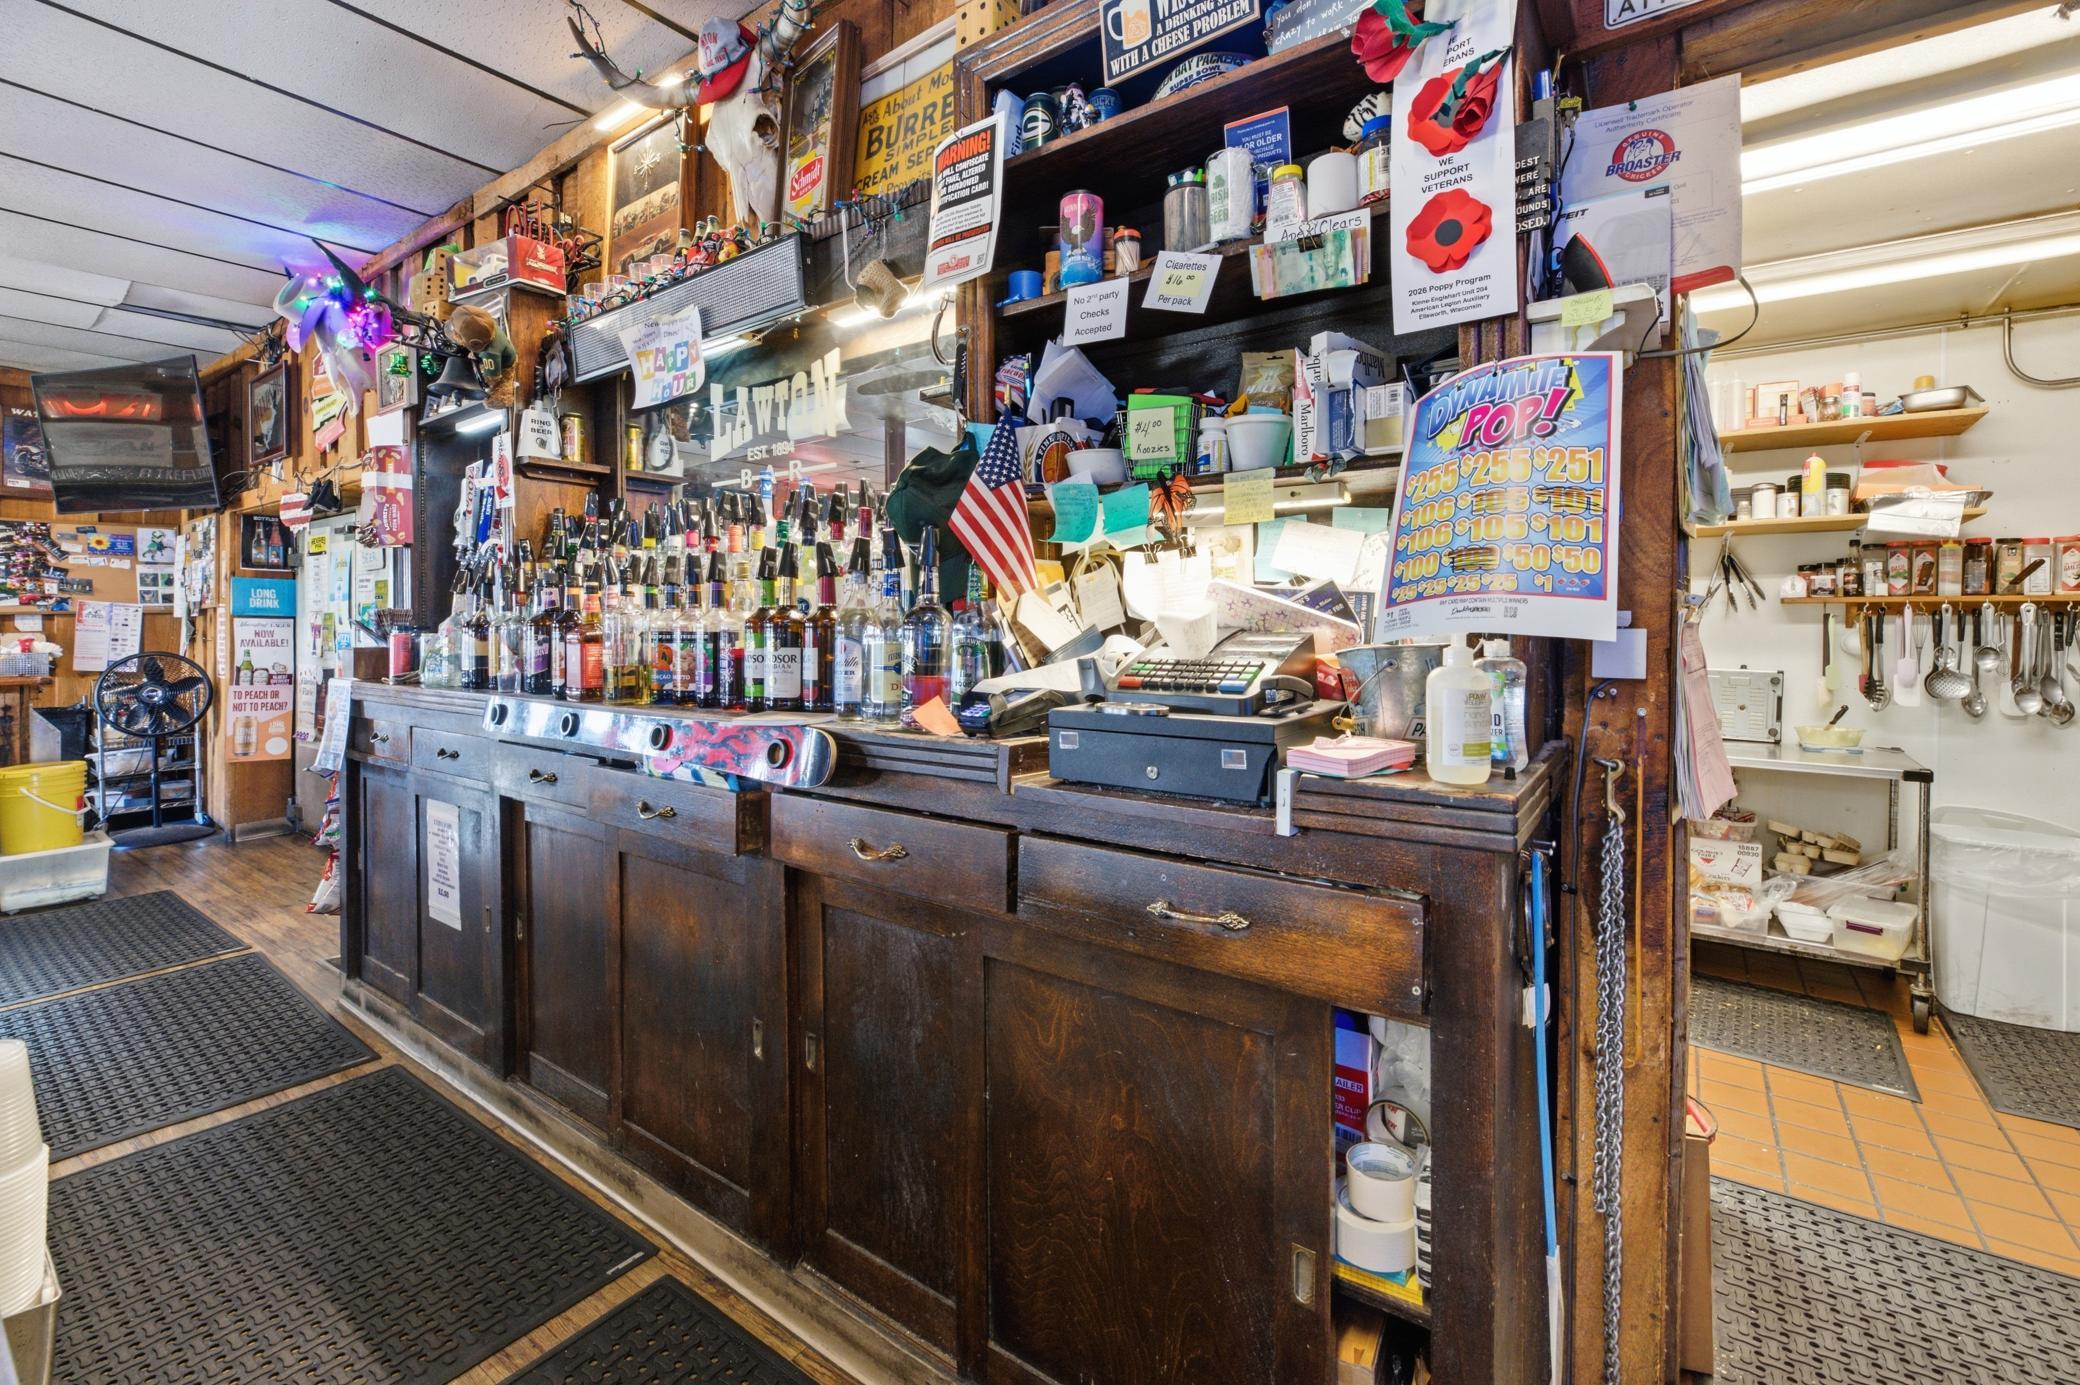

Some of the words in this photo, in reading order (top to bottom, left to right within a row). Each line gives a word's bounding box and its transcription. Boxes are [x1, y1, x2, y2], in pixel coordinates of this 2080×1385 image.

[1156, 23, 1162, 36] A
[1164, 1, 1215, 33] DRINKING
[1110, 51, 1140, 76] WITH
[1141, 45, 1150, 62] A
[1151, 26, 1191, 57] CHEESE
[1193, 1, 1252, 38] PROBLEM
[1174, 58, 1194, 80] BAY
[1195, 53, 1245, 67] PACKERS
[1169, 73, 1196, 92] SUPER
[1195, 63, 1223, 77] BOWL
[883, 86, 922, 120] About
[1626, 109, 1661, 122] Trademark
[1662, 100, 1695, 114] Operator
[1605, 120, 1646, 134] Authenticity
[1646, 110, 1682, 124] Certificate
[884, 120, 954, 162] SIMPLE
[1010, 125, 1023, 156] Find
[1246, 140, 1256, 150] OR
[1257, 133, 1283, 148] OLDER
[1252, 131, 1265, 140] MUST
[1622, 130, 1665, 148] GENUINE
[937, 130, 991, 174] WARNING!
[1438, 156, 1454, 168] WE
[857, 161, 900, 192] CREAM
[906, 141, 942, 170] SEP
[955, 152, 990, 174] CONFISCATE
[961, 163, 986, 179] ALTERED
[1424, 163, 1471, 183] SUPPORT
[1605, 150, 1682, 178] BROASTER
[1624, 165, 1664, 180] CHICKEN
[792, 160, 821, 196] Schmidt
[947, 175, 980, 194] BORROWED
[1421, 173, 1474, 194] VETERANS
[1528, 184, 1548, 198] ARE
[1165, 259, 1208, 272] Cigarettes
[1408, 287, 1428, 298] 2026
[1428, 282, 1454, 294] Poppy
[1455, 274, 1492, 287] Program
[1073, 296, 1086, 306] No
[1086, 293, 1099, 304] 2nd
[1099, 289, 1120, 302] party
[1157, 294, 1172, 305] Per
[1171, 295, 1193, 308] pack
[1410, 303, 1440, 314] American
[1440, 298, 1462, 308] Legion
[1462, 293, 1491, 304] Auxiliary
[1080, 307, 1110, 320] Checks
[1449, 303, 1482, 314] Wisconsin
[1074, 322, 1113, 337] Accepted
[710, 347, 842, 462] LAWTON
[530, 418, 552, 428] RING
[1458, 386, 1572, 450] POP!
[530, 427, 552, 436] BEER
[1300, 403, 1315, 456] Marlboro
[747, 444, 770, 462] EST.
[1038, 431, 1056, 458] FINE
[1136, 443, 1170, 454] Koozies
[1406, 458, 1460, 505] $255
[1460, 447, 1532, 488] $255
[1533, 446, 1605, 484] $251
[1400, 496, 1456, 531] $106
[1457, 486, 1530, 516] $105
[1397, 521, 1454, 556] $106
[1454, 513, 1530, 542] $105
[1530, 512, 1604, 544] $101
[1393, 550, 1440, 583] $100
[1502, 542, 1551, 572] $50
[1551, 543, 1602, 576] $50
[251, 588, 277, 600] LONG
[1391, 583, 1419, 602] $25
[1417, 577, 1448, 597] $25
[1447, 573, 1482, 594] $25
[1481, 572, 1518, 592] $25
[1534, 573, 1554, 594] $1
[249, 597, 280, 610] DRINK
[239, 637, 290, 648] AVAILABLE!
[254, 629, 276, 639] NOW
[233, 690, 244, 700] TO
[244, 690, 270, 700] PEACH
[270, 690, 280, 700] OR
[232, 702, 248, 712] NOT
[249, 702, 260, 712] TO
[260, 701, 288, 712] PEACH?
[1336, 1078, 1364, 1093] AILER
